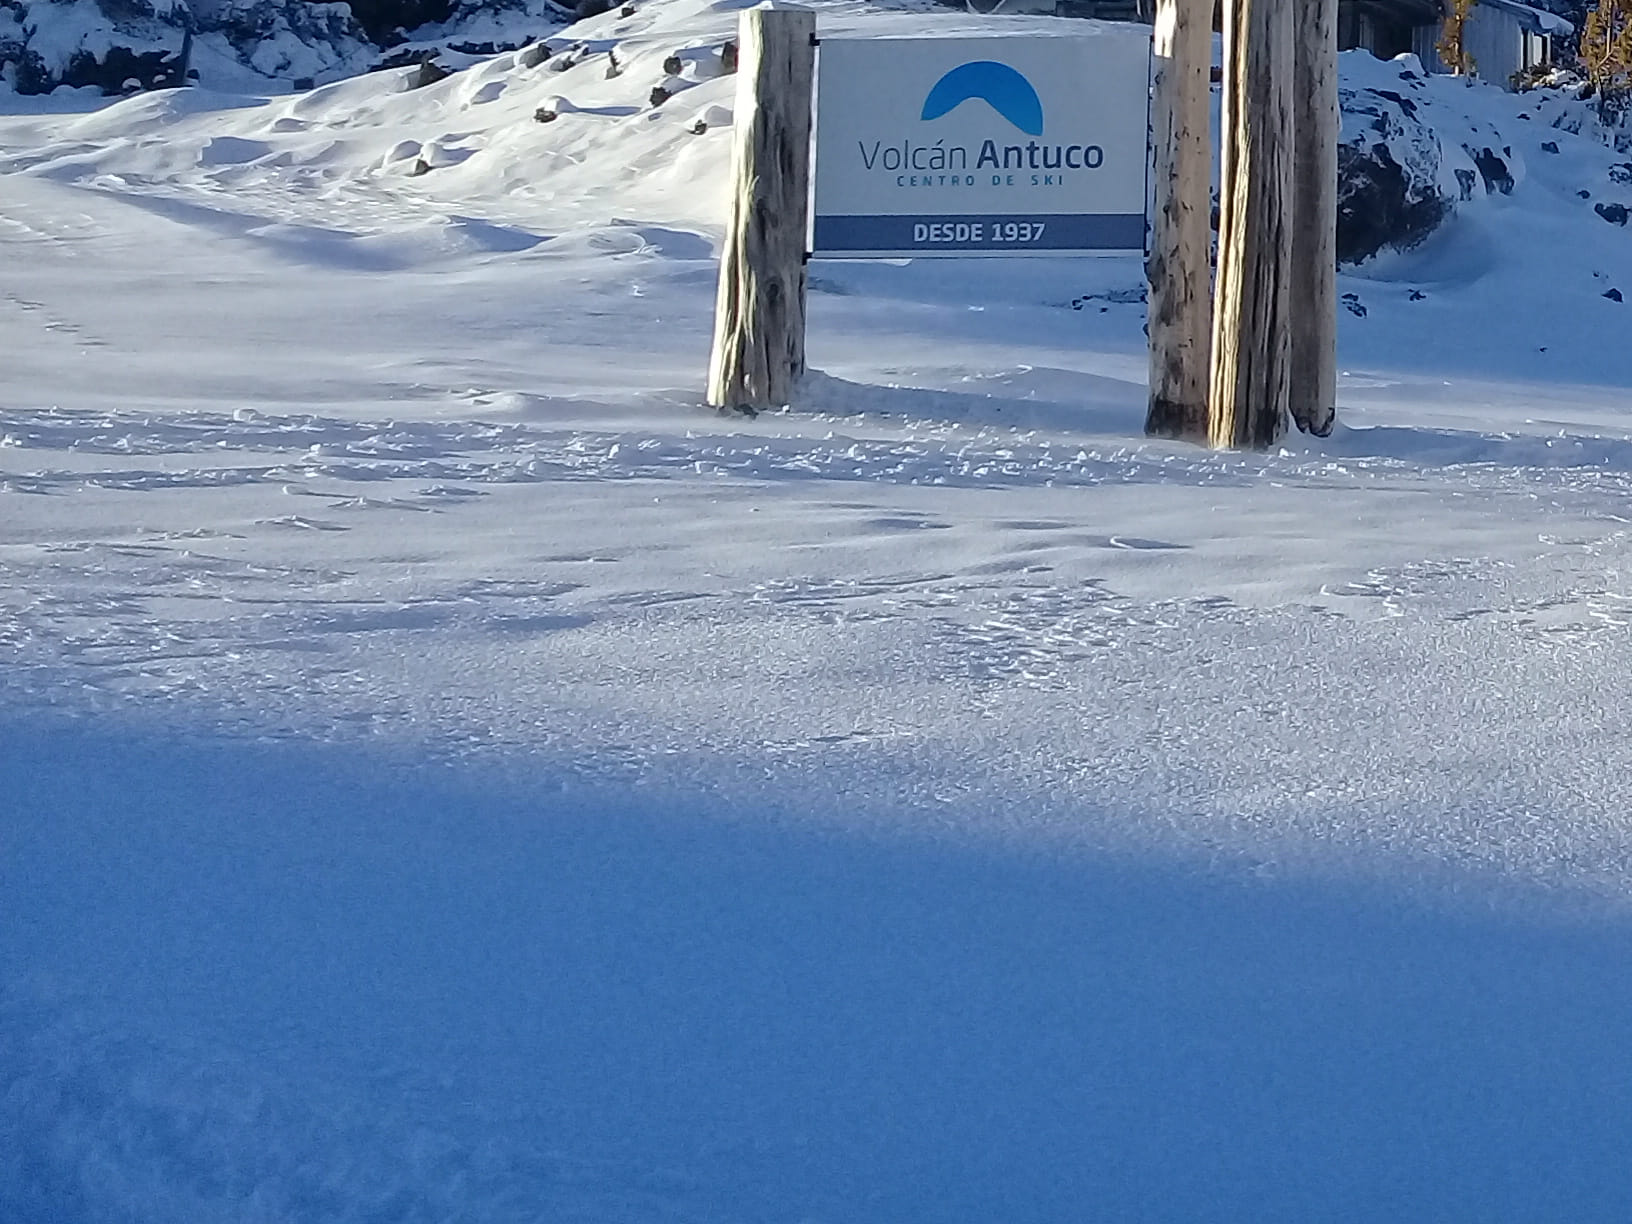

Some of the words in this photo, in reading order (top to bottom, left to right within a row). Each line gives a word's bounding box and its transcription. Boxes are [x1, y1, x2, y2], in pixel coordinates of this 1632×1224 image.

[858, 139, 967, 170] Volcán
[976, 139, 1103, 169] Antuco
[897, 176, 974, 187] CENTRO
[992, 175, 1014, 186] DE
[1032, 175, 1063, 186] SKI
[913, 224, 983, 242] DESDE
[992, 224, 1045, 241] 1937
